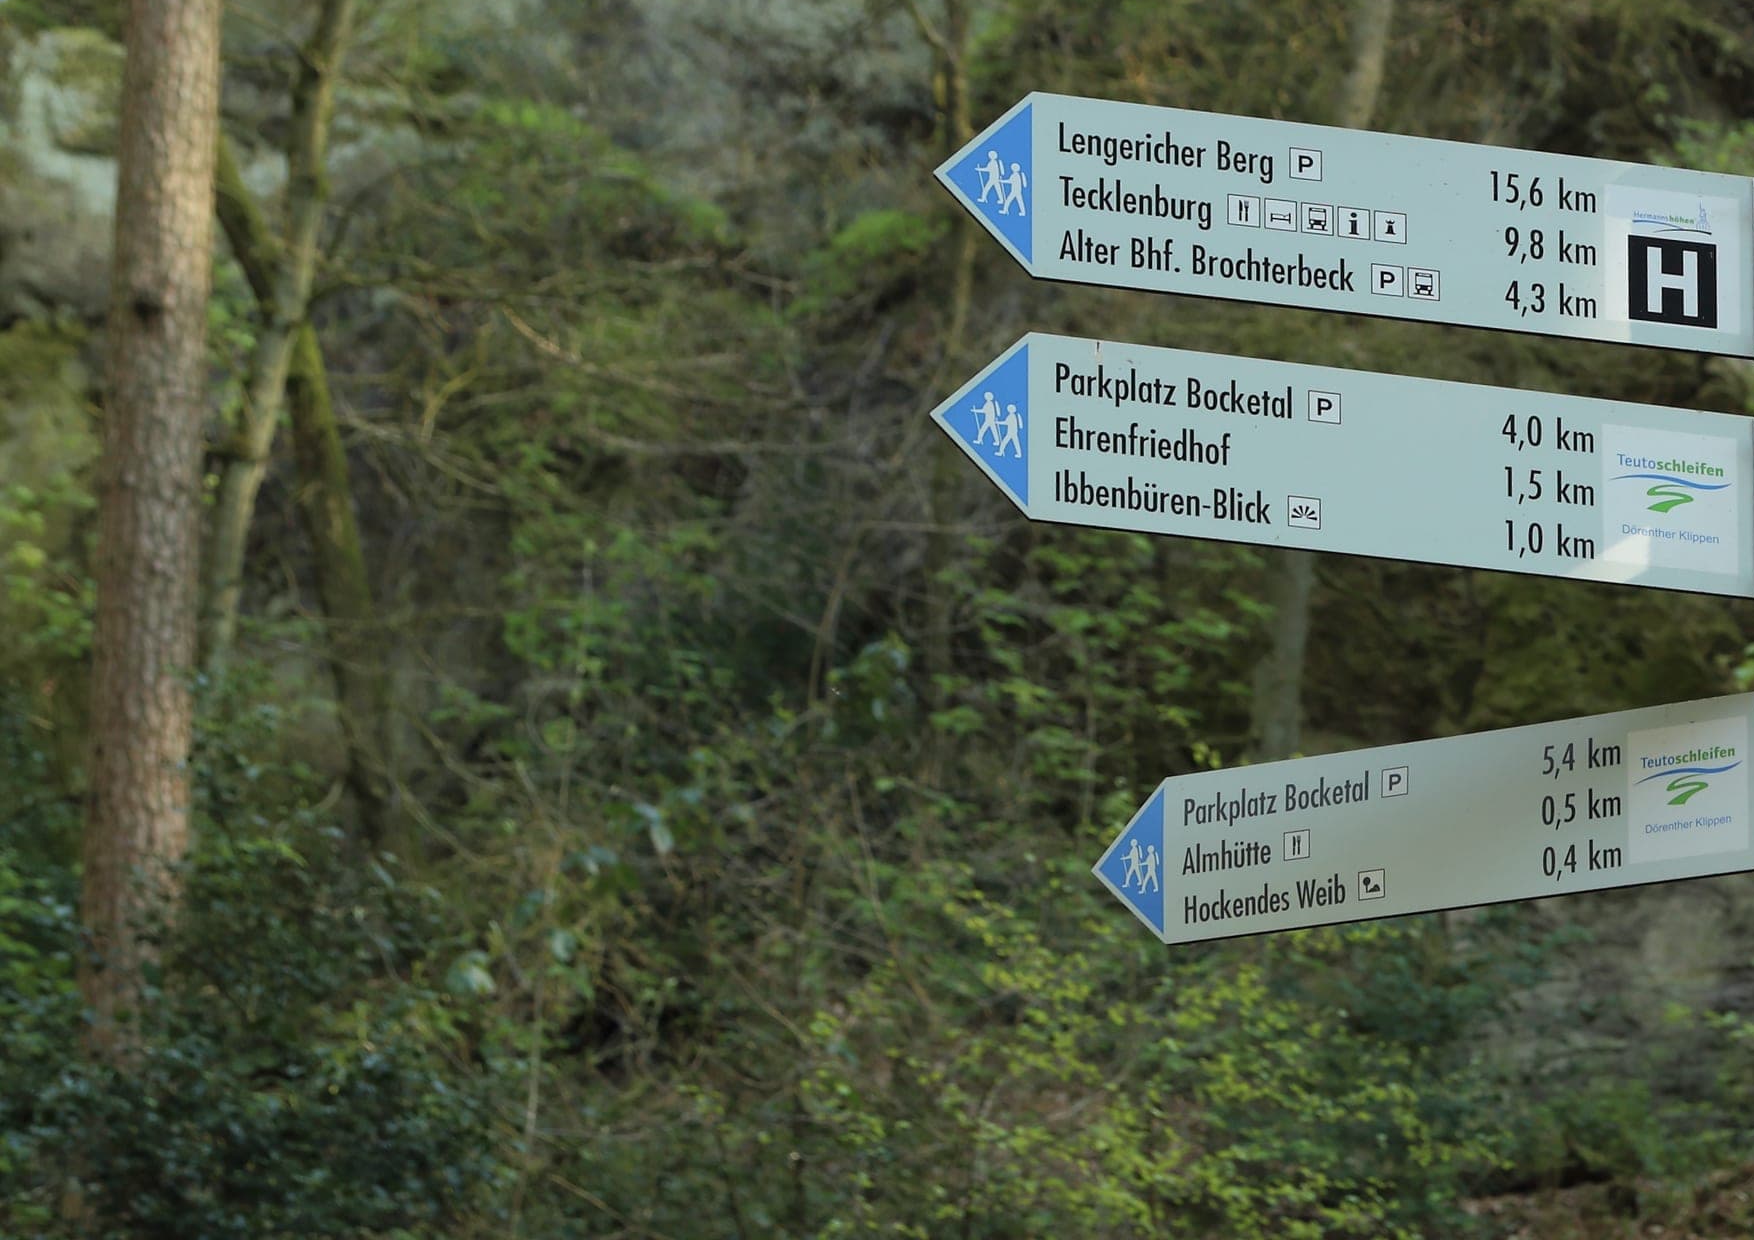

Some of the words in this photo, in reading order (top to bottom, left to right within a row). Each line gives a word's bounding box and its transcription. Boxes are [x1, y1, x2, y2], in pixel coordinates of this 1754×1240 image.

[1059, 122, 1206, 168] Lengericher
[1217, 140, 1274, 184] Berg
[1059, 176, 1212, 230] Tecklenburg
[1490, 170, 1543, 211] 15,6
[1559, 177, 1596, 213] km
[1633, 210, 1695, 225] Hermannshöhen
[1059, 230, 1120, 265] Alter
[1131, 237, 1181, 273] Bhf.
[1192, 244, 1354, 292] Brochterbeck
[1504, 227, 1544, 265] 9,8
[1559, 230, 1596, 266] km
[1505, 280, 1545, 317] 4,3
[1559, 282, 1596, 319] km
[1647, 246, 1698, 318] H
[1055, 362, 1176, 408] Parkplatz
[1187, 377, 1292, 419] Bocketal
[1055, 415, 1231, 466] Ehrenfriedhof
[1502, 414, 1542, 451] 4,0
[1557, 417, 1594, 453] km
[1504, 466, 1542, 505] 1,5
[1557, 470, 1594, 506] km
[1617, 453, 1724, 478] Teutoschleifen
[1055, 469, 1271, 524] Ibbenbüren-Blick
[1505, 520, 1543, 558] 1,0
[1557, 523, 1595, 560] km
[1622, 524, 1676, 540] Dörenther
[1679, 530, 1719, 545] Klippen
[1542, 742, 1575, 780] 5,4
[1588, 738, 1621, 769] km
[1640, 745, 1735, 770] Teutoschleifen
[1184, 788, 1277, 827] Parkplatz
[1285, 770, 1369, 812] Bocketal
[1541, 793, 1576, 830] 0,5
[1588, 788, 1621, 820] km
[1645, 820, 1692, 834] Dörenther
[1695, 814, 1732, 829] Klippen
[1182, 840, 1271, 875] Almhütte
[1542, 844, 1576, 882] 0,4
[1589, 839, 1622, 871] km
[1184, 883, 1289, 925] Hockendes
[1296, 873, 1346, 908] Weib
